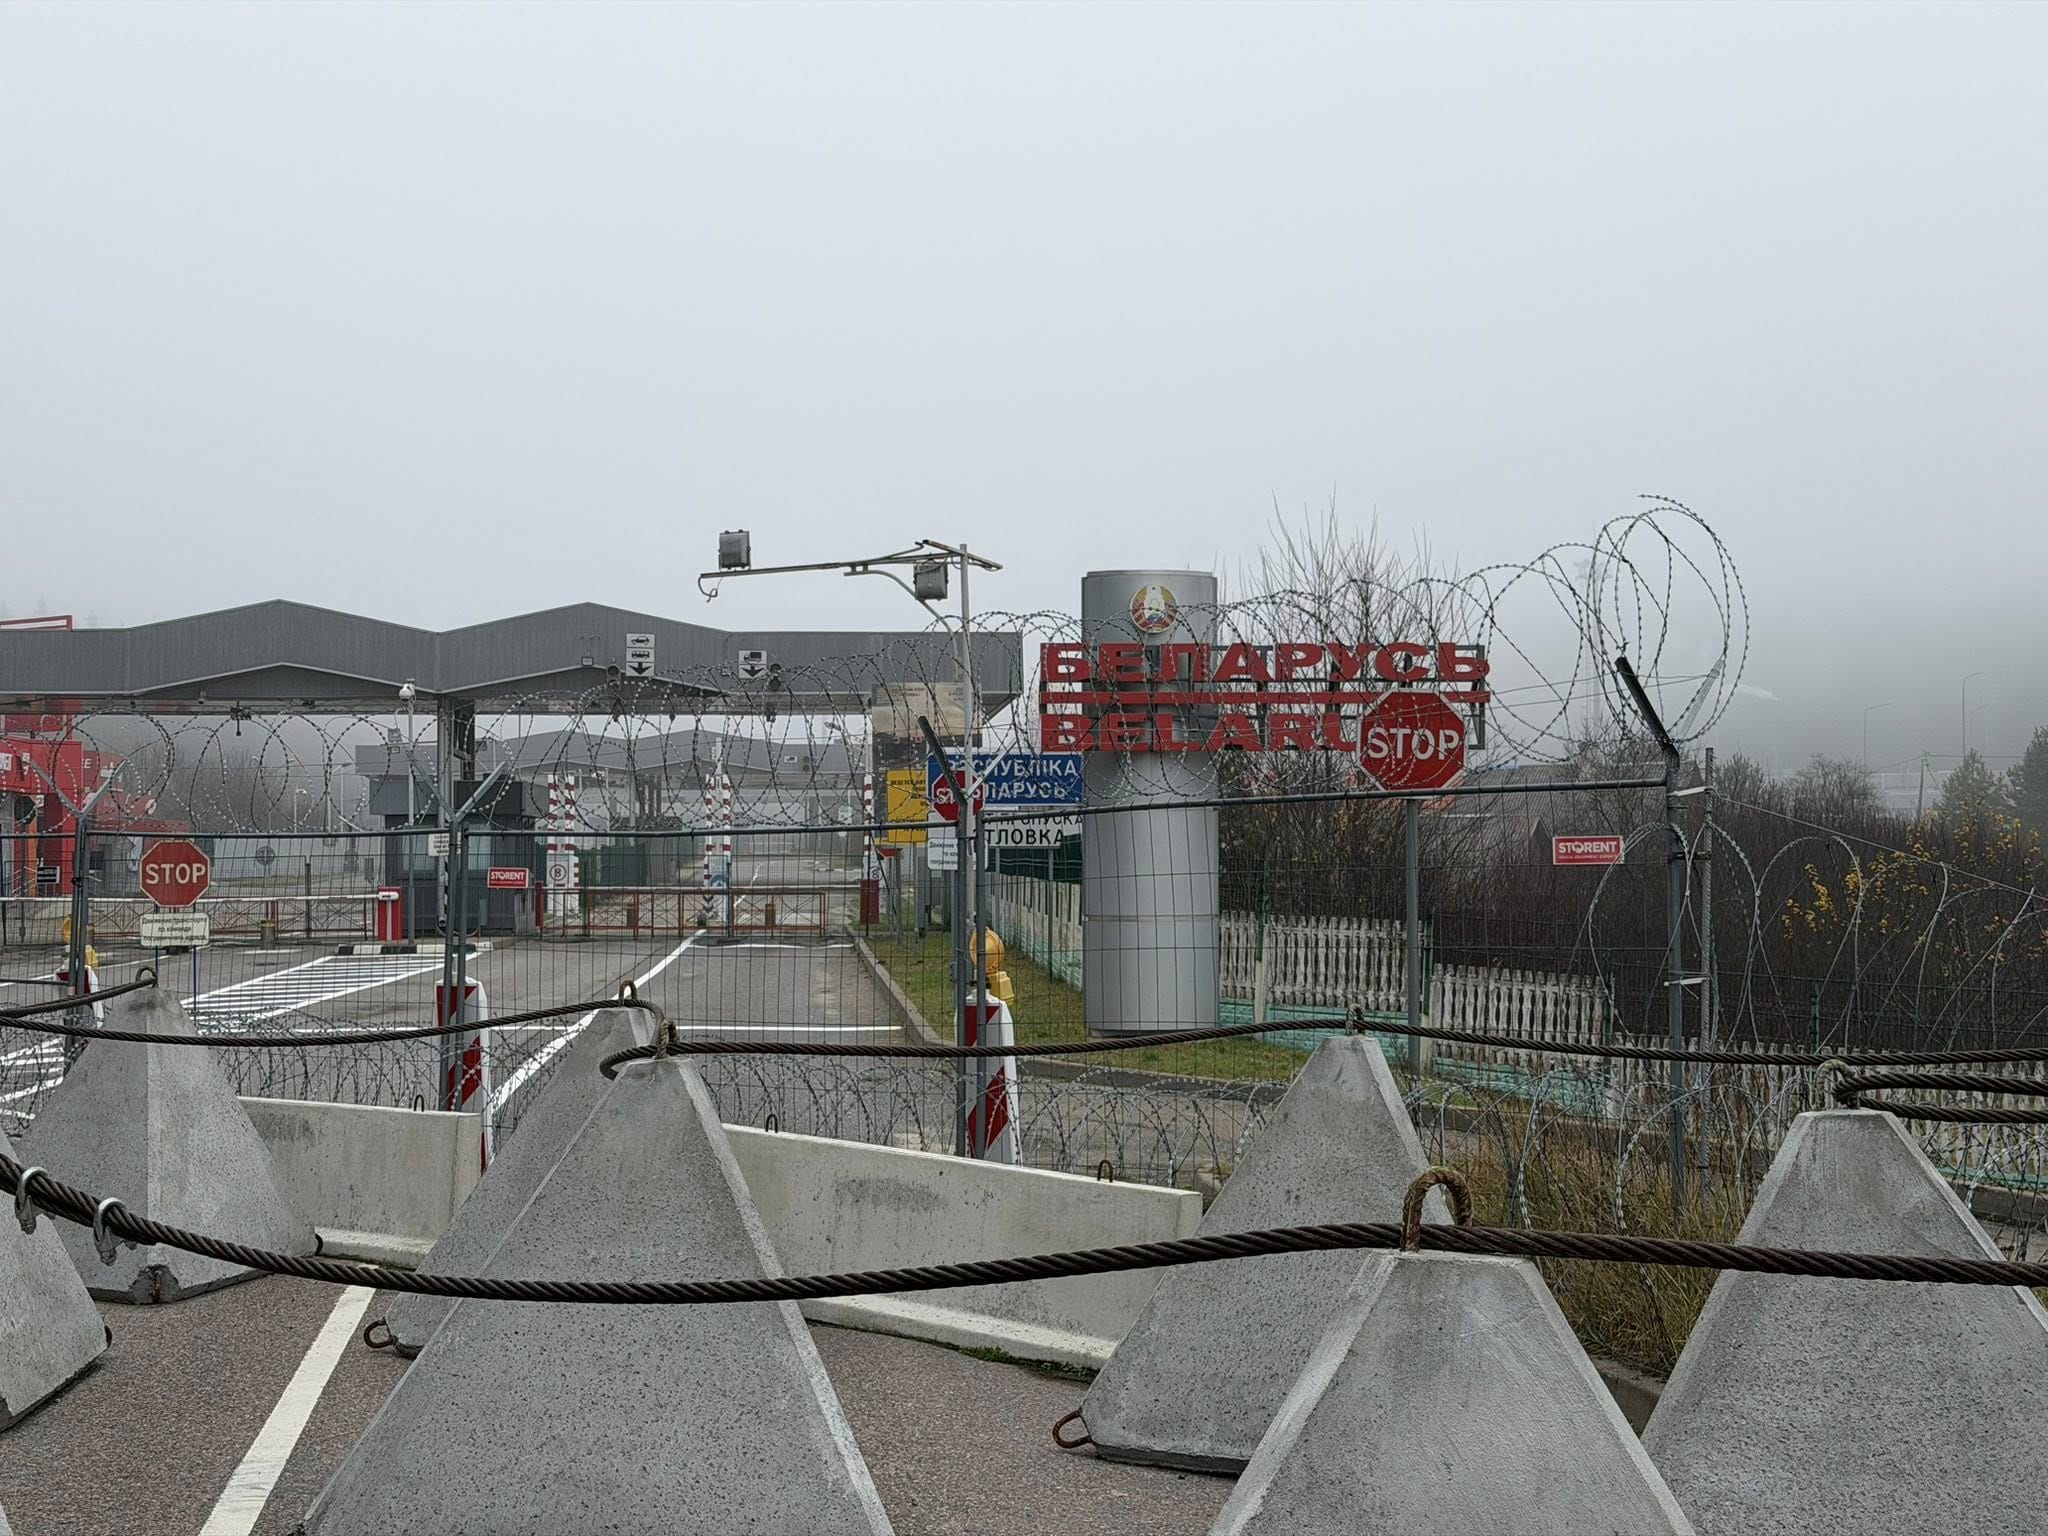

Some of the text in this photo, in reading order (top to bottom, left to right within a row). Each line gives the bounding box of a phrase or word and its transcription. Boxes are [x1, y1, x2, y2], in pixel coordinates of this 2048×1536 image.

[1040, 642, 1490, 682] БЕЛАРУСЬ
[1041, 712, 1358, 752] BELARU
[1367, 726, 1460, 761] STOP
[985, 781, 1065, 799] ЛАРУСЬ
[985, 828, 1065, 845] ТЛОВКА
[1558, 841, 1617, 854] STORENT
[145, 863, 206, 884] STOP
[490, 871, 525, 880] STORENT
